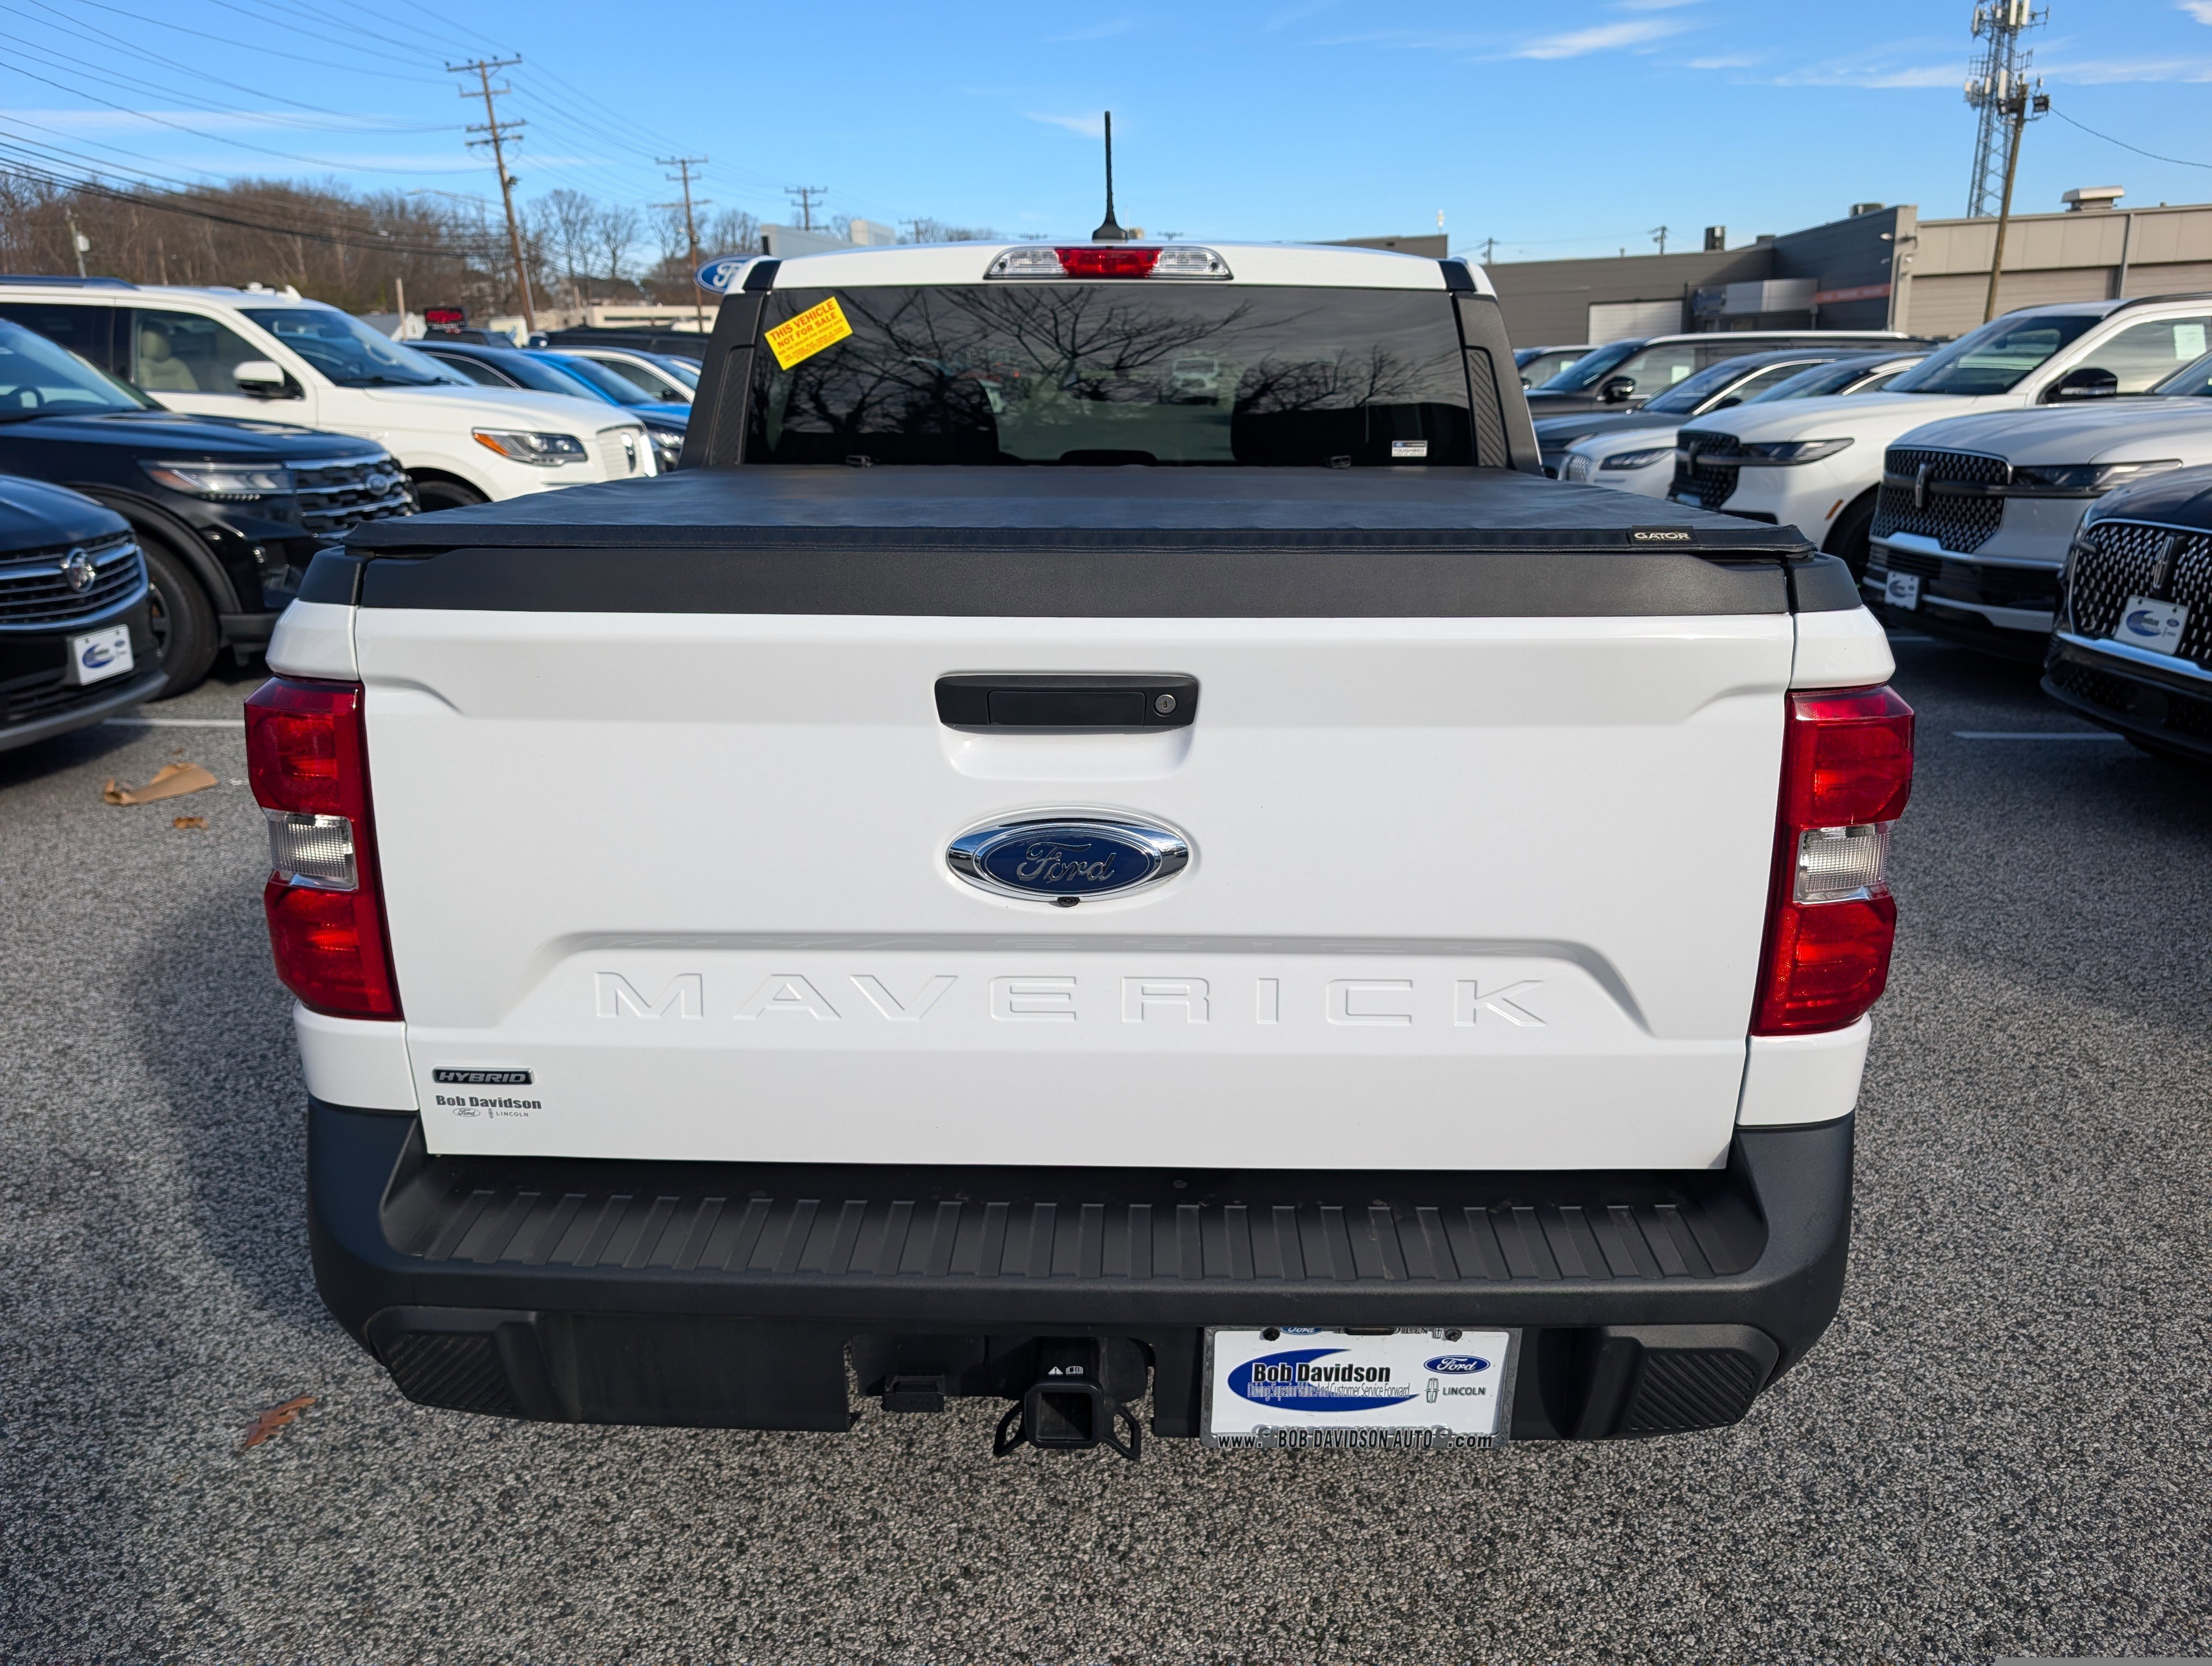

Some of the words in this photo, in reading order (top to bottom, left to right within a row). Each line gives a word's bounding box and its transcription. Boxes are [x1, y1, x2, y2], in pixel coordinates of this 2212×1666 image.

[770, 324, 793, 341] THIS
[793, 301, 835, 328] VEHICLE
[777, 334, 794, 349] NOT
[795, 325, 814, 338] FOR
[814, 312, 837, 328] SALE
[1017, 842, 1117, 883] Ford
[595, 972, 1547, 1026] MAVERICK
[439, 1072, 526, 1082] HYBRID
[435, 1094, 466, 1106] Bob
[468, 1096, 542, 1110] Davidson
[1253, 1363, 1293, 1382] Bob
[1296, 1363, 1391, 1382] Davidson
[1436, 1357, 1478, 1370] Ford
[1248, 1382, 1270, 1401] Driving
[1271, 1382, 1298, 1401] Superior
[1316, 1382, 1329, 1398] And
[1330, 1382, 1360, 1397] Customer
[1361, 1382, 1382, 1397] Service
[1384, 1382, 1411, 1398] Forward
[1442, 1387, 1486, 1395] LINCOLN
[1277, 1428, 1309, 1448] BOB
[1313, 1428, 1388, 1448] DAVIDSON
[1393, 1428, 1432, 1448] AUTO
